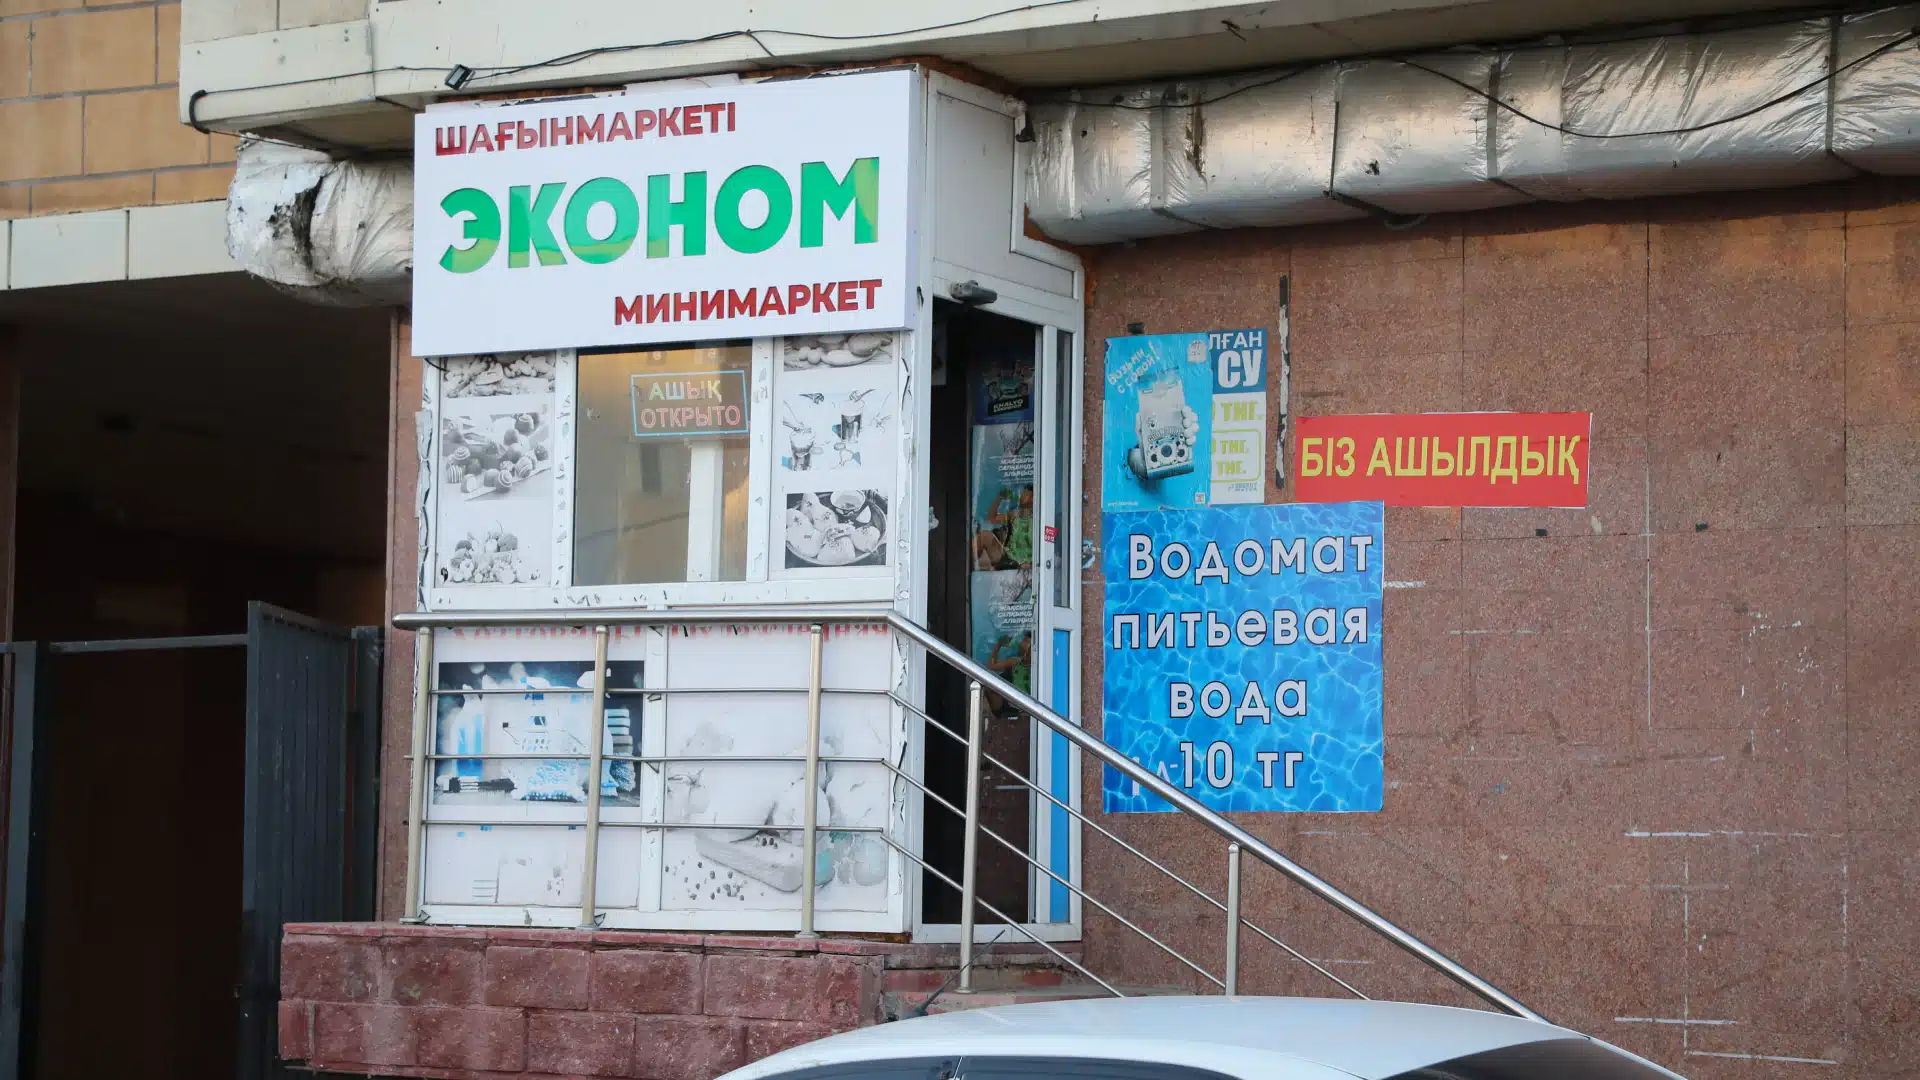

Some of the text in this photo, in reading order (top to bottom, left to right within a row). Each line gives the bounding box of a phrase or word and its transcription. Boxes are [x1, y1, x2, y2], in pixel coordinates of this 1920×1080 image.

[435, 101, 736, 157] ШАҒЫНМАРКЕТІ
[438, 156, 881, 275] ЭКОНОМ
[614, 278, 883, 326] МИНИМАРКЕТ
[648, 379, 723, 403] АШЫҚ
[1217, 349, 1263, 389] СУ
[640, 405, 741, 429] ОТКРЫТО
[1301, 435, 1581, 485] БІЗ АШЫЛДЫҚ
[1128, 532, 1373, 586] Водомат
[1112, 607, 1368, 650] питьевая
[1169, 679, 1308, 726] вода
[1256, 751, 1304, 789] тг
